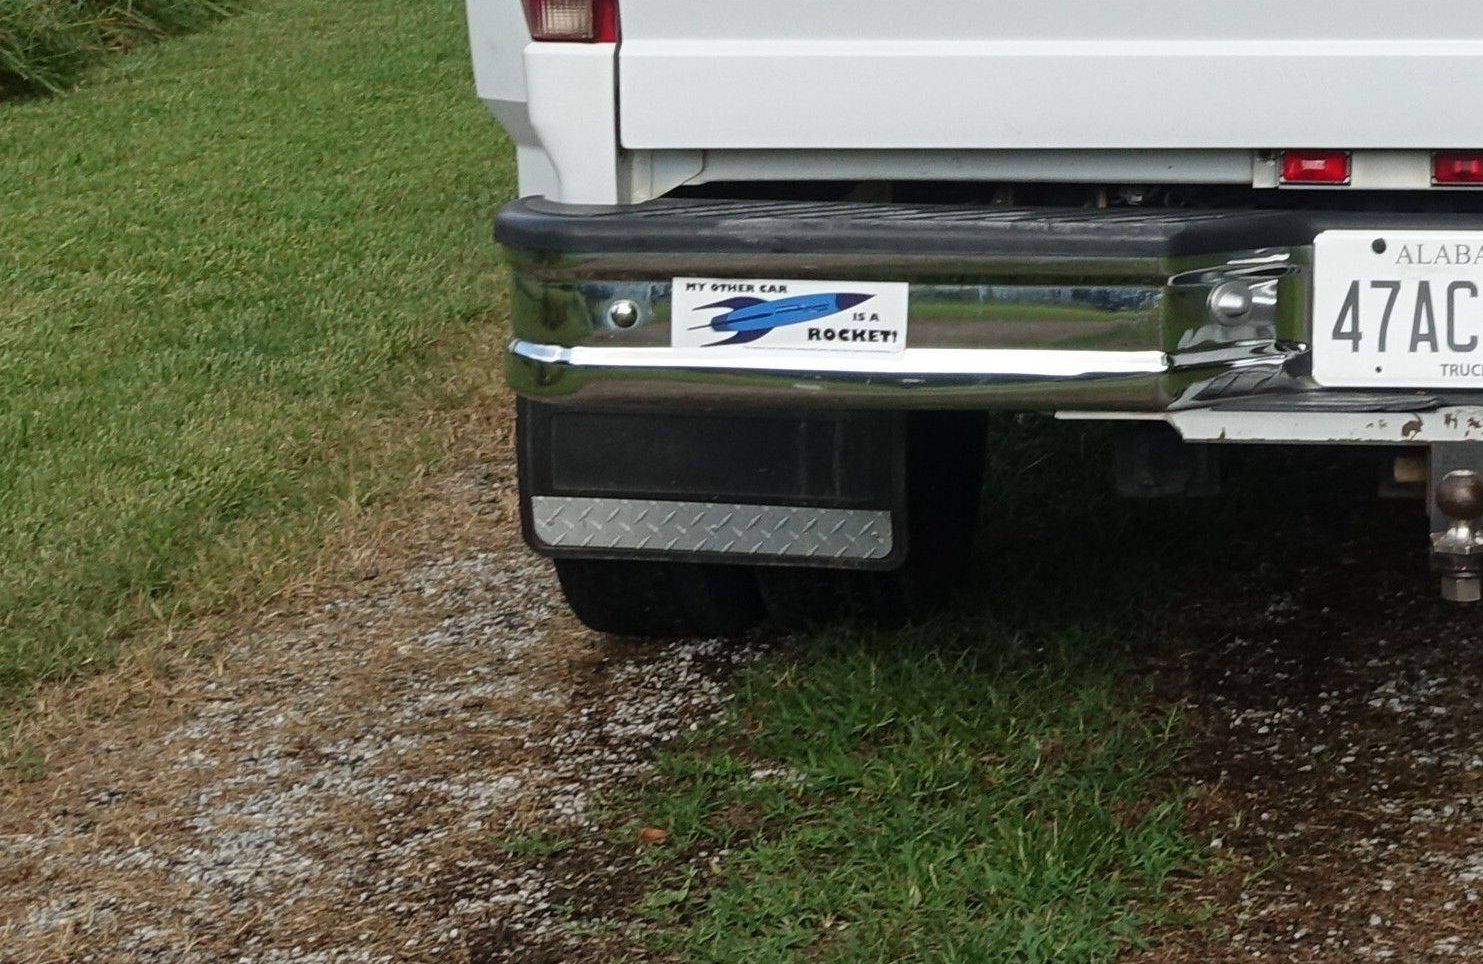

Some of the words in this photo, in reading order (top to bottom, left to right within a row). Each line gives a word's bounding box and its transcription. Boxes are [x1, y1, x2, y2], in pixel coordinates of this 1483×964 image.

[686, 283, 706, 292] MY
[711, 284, 755, 293] OTHER
[760, 285, 788, 294] CAR
[853, 312, 866, 321] IS
[869, 312, 880, 322] A
[807, 328, 898, 343] ROCKET!
